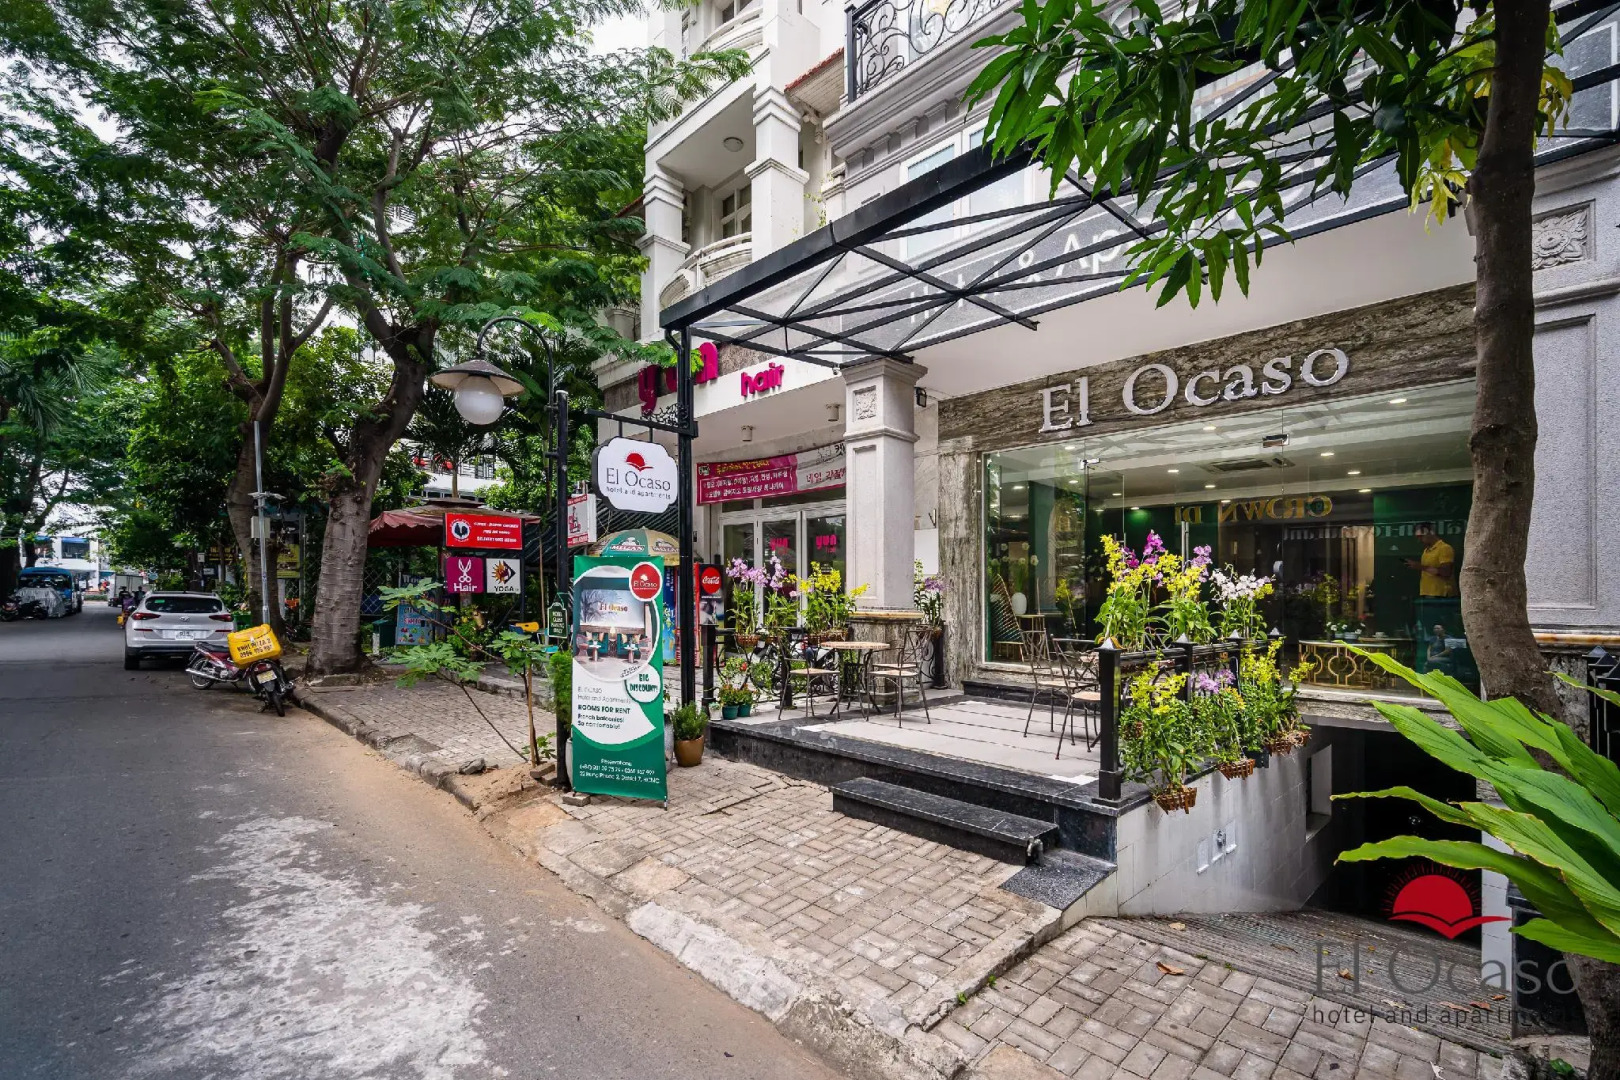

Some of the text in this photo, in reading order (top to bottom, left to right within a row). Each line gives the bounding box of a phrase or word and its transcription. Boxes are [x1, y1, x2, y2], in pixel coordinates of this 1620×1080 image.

[741, 362, 785, 397] hair
[1038, 348, 1349, 433] El Ocaso
[606, 467, 671, 491] El Ocaso
[815, 534, 837, 550] yun
[453, 582, 478, 592] Hair
[638, 673, 650, 682] BIG
[577, 704, 600, 712] ROOMS
